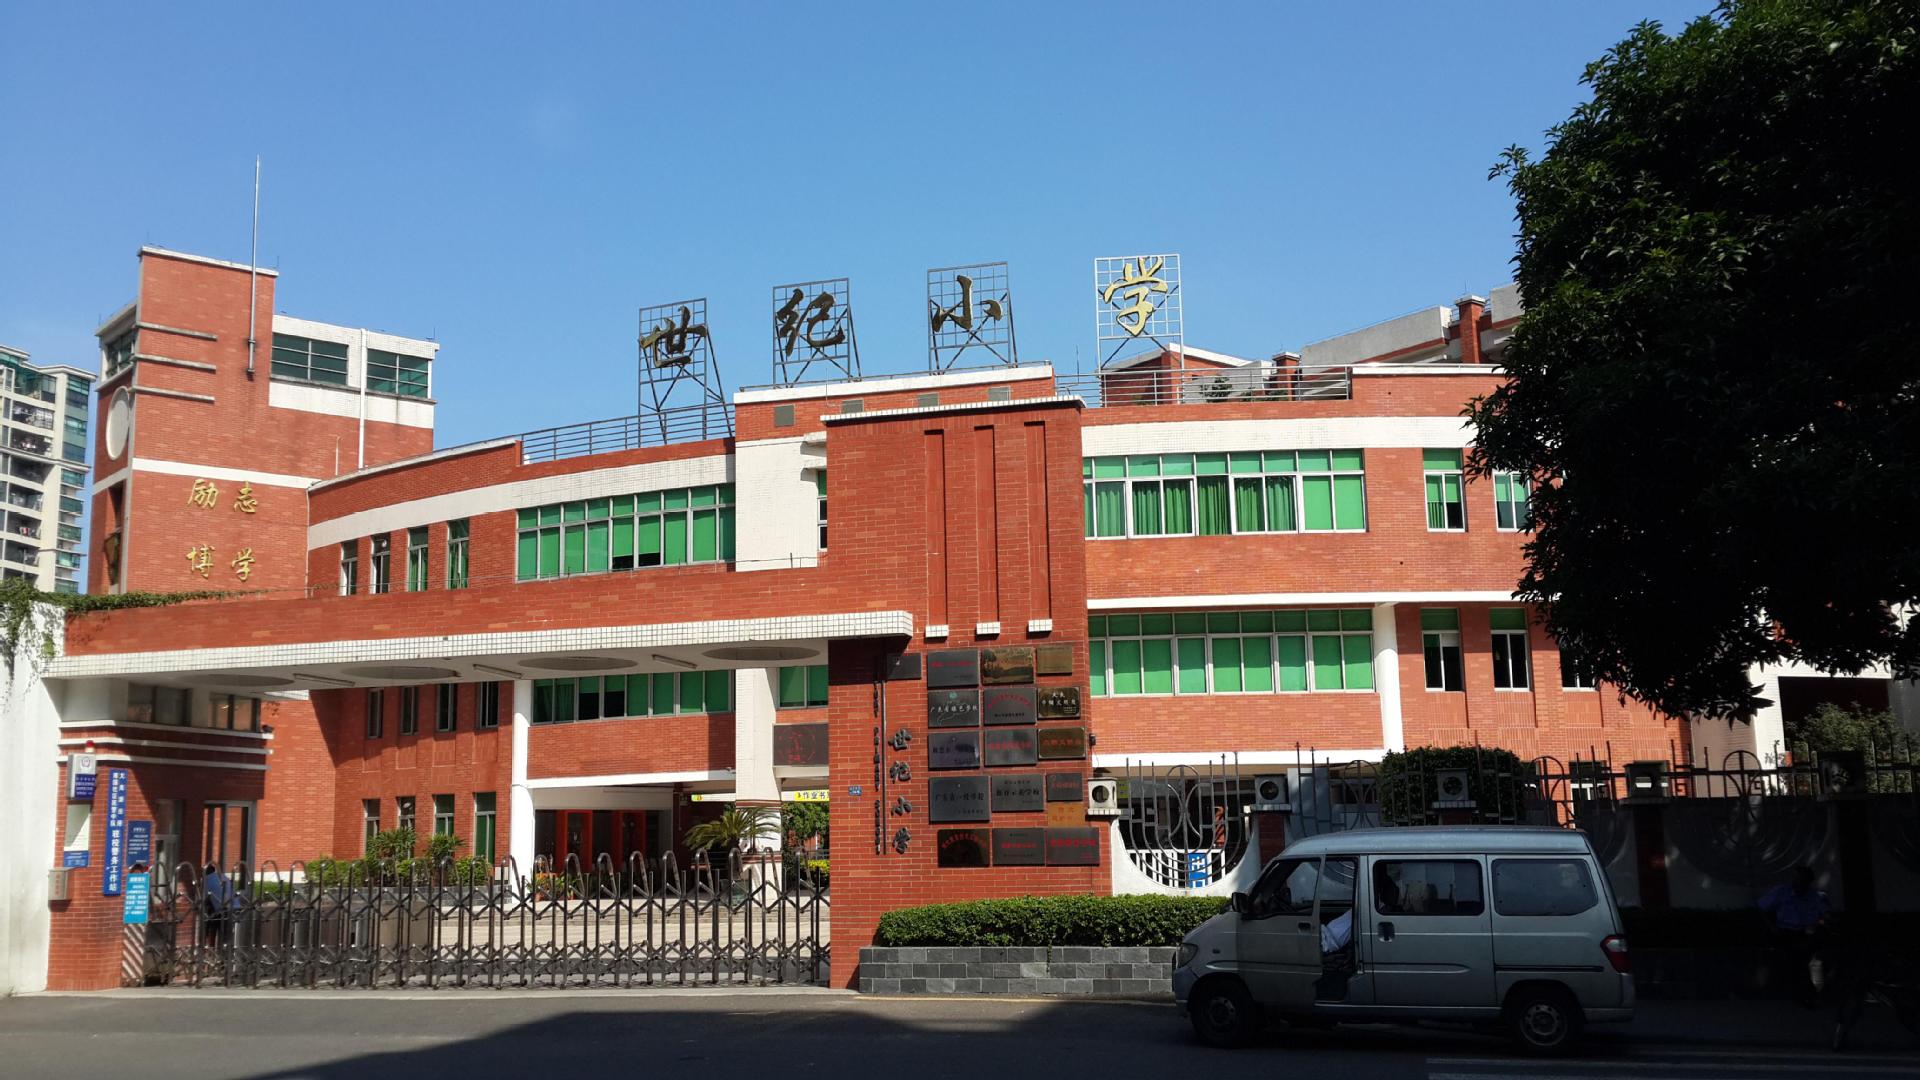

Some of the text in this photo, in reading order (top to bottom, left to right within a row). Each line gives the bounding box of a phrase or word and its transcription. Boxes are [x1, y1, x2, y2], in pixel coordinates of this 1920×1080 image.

[639, 255, 1168, 368] 世纪小学
[187, 478, 259, 514] 励志
[185, 543, 256, 581] 博学
[888, 727, 912, 855] 世纪小学
